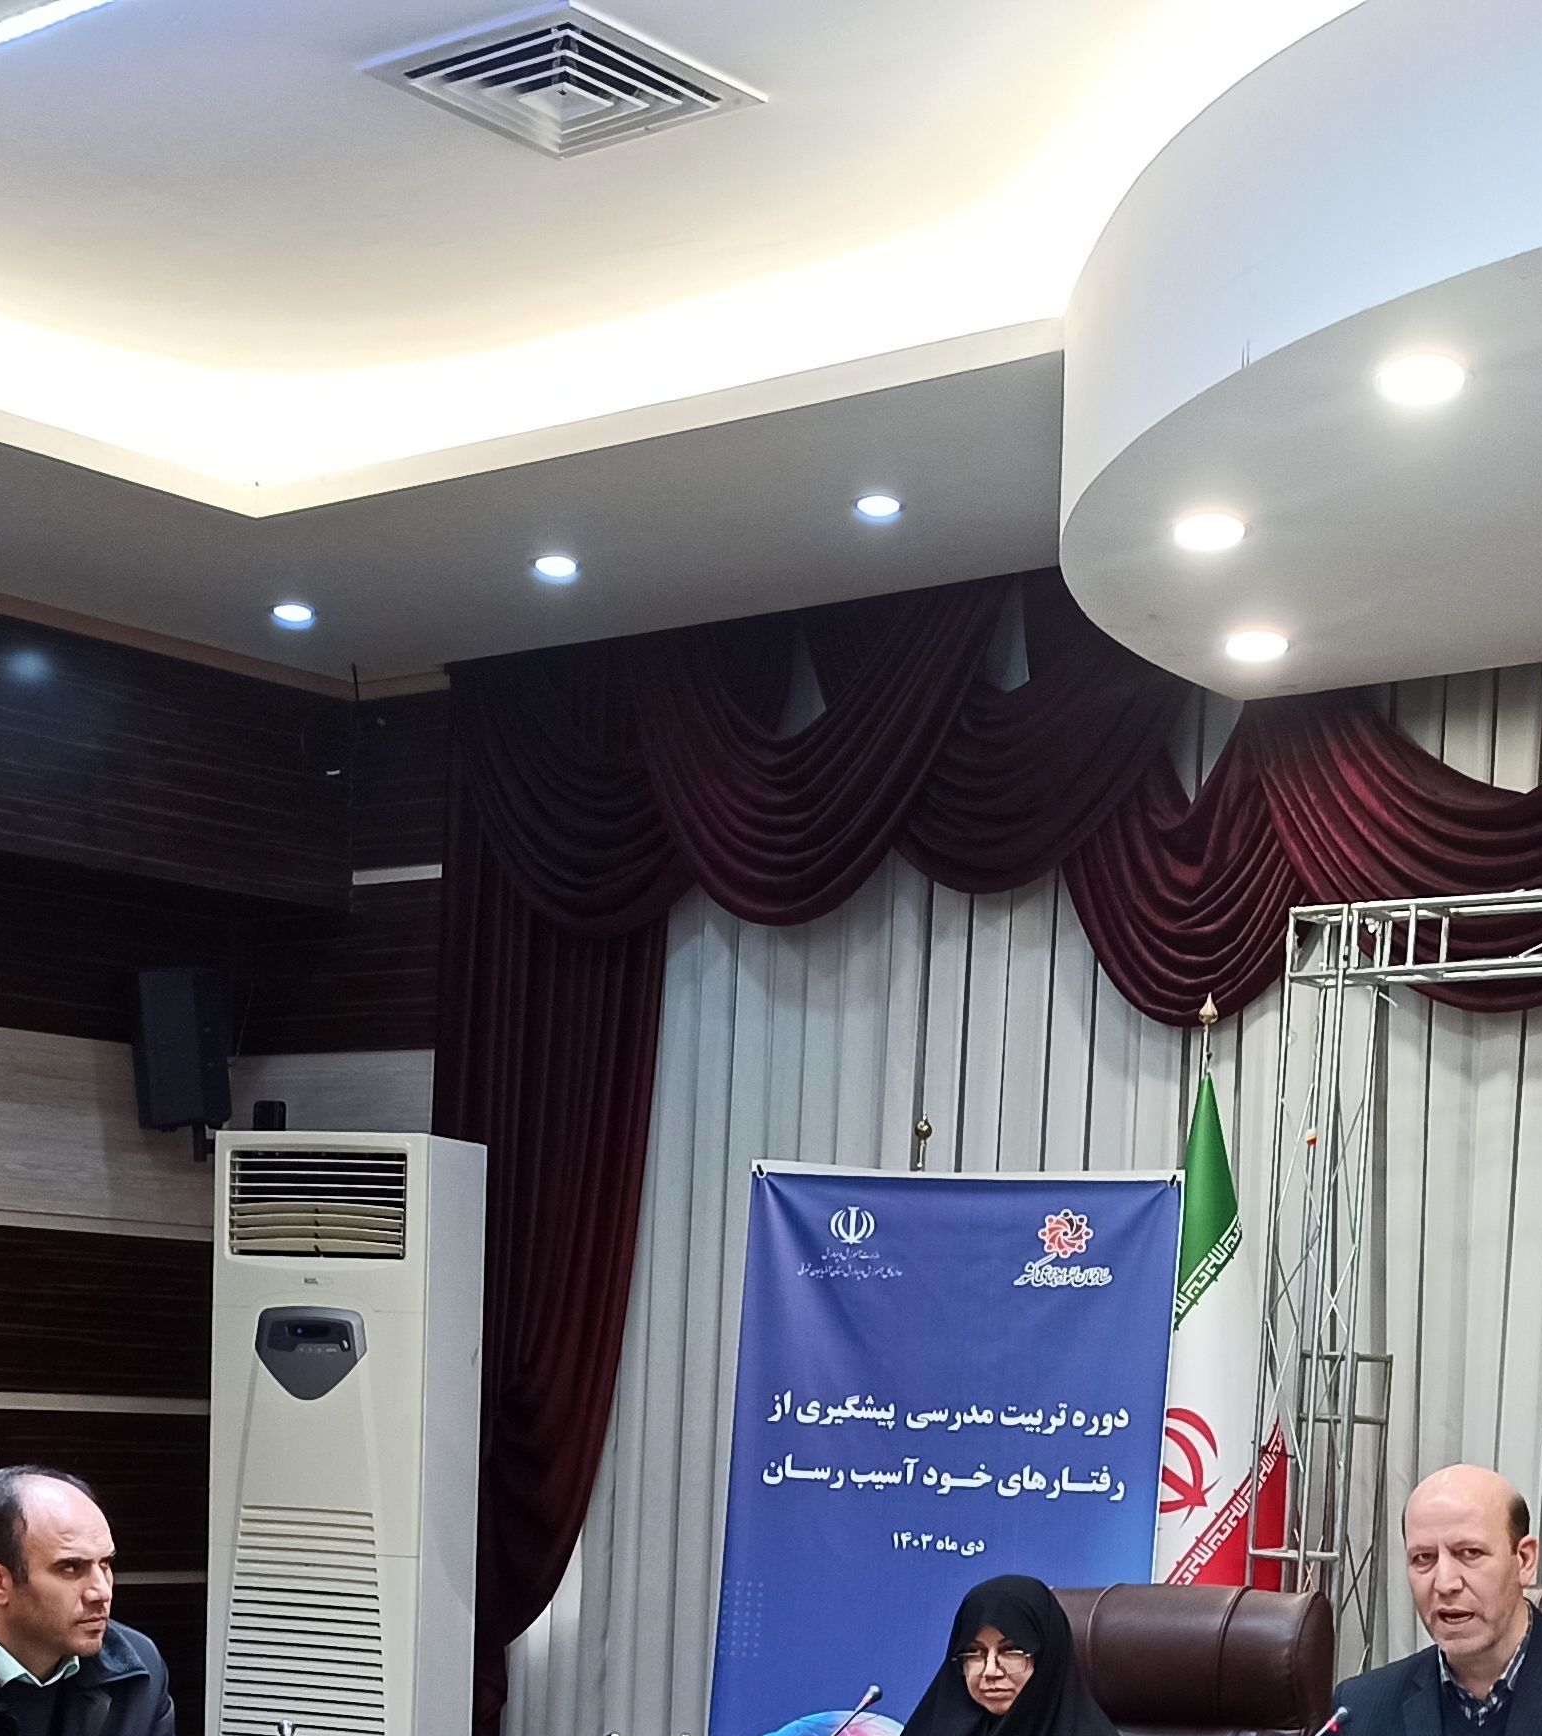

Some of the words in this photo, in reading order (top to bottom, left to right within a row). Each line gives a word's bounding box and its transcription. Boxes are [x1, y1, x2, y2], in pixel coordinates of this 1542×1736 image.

[767, 1390, 792, 1422] از
[796, 1394, 896, 1430] پیشگیری
[906, 1404, 994, 1431] مدرسی
[999, 1402, 1068, 1435] تربیت
[1072, 1407, 1129, 1436] دوره
[762, 1453, 845, 1489] رسان
[850, 1457, 920, 1490] آسیب
[922, 1464, 993, 1495] خود
[997, 1464, 1125, 1501] رفتارهای
[892, 1530, 933, 1551] ۱۴۰۳
[936, 1535, 958, 1551] ماه
[960, 1539, 985, 1556] دی
